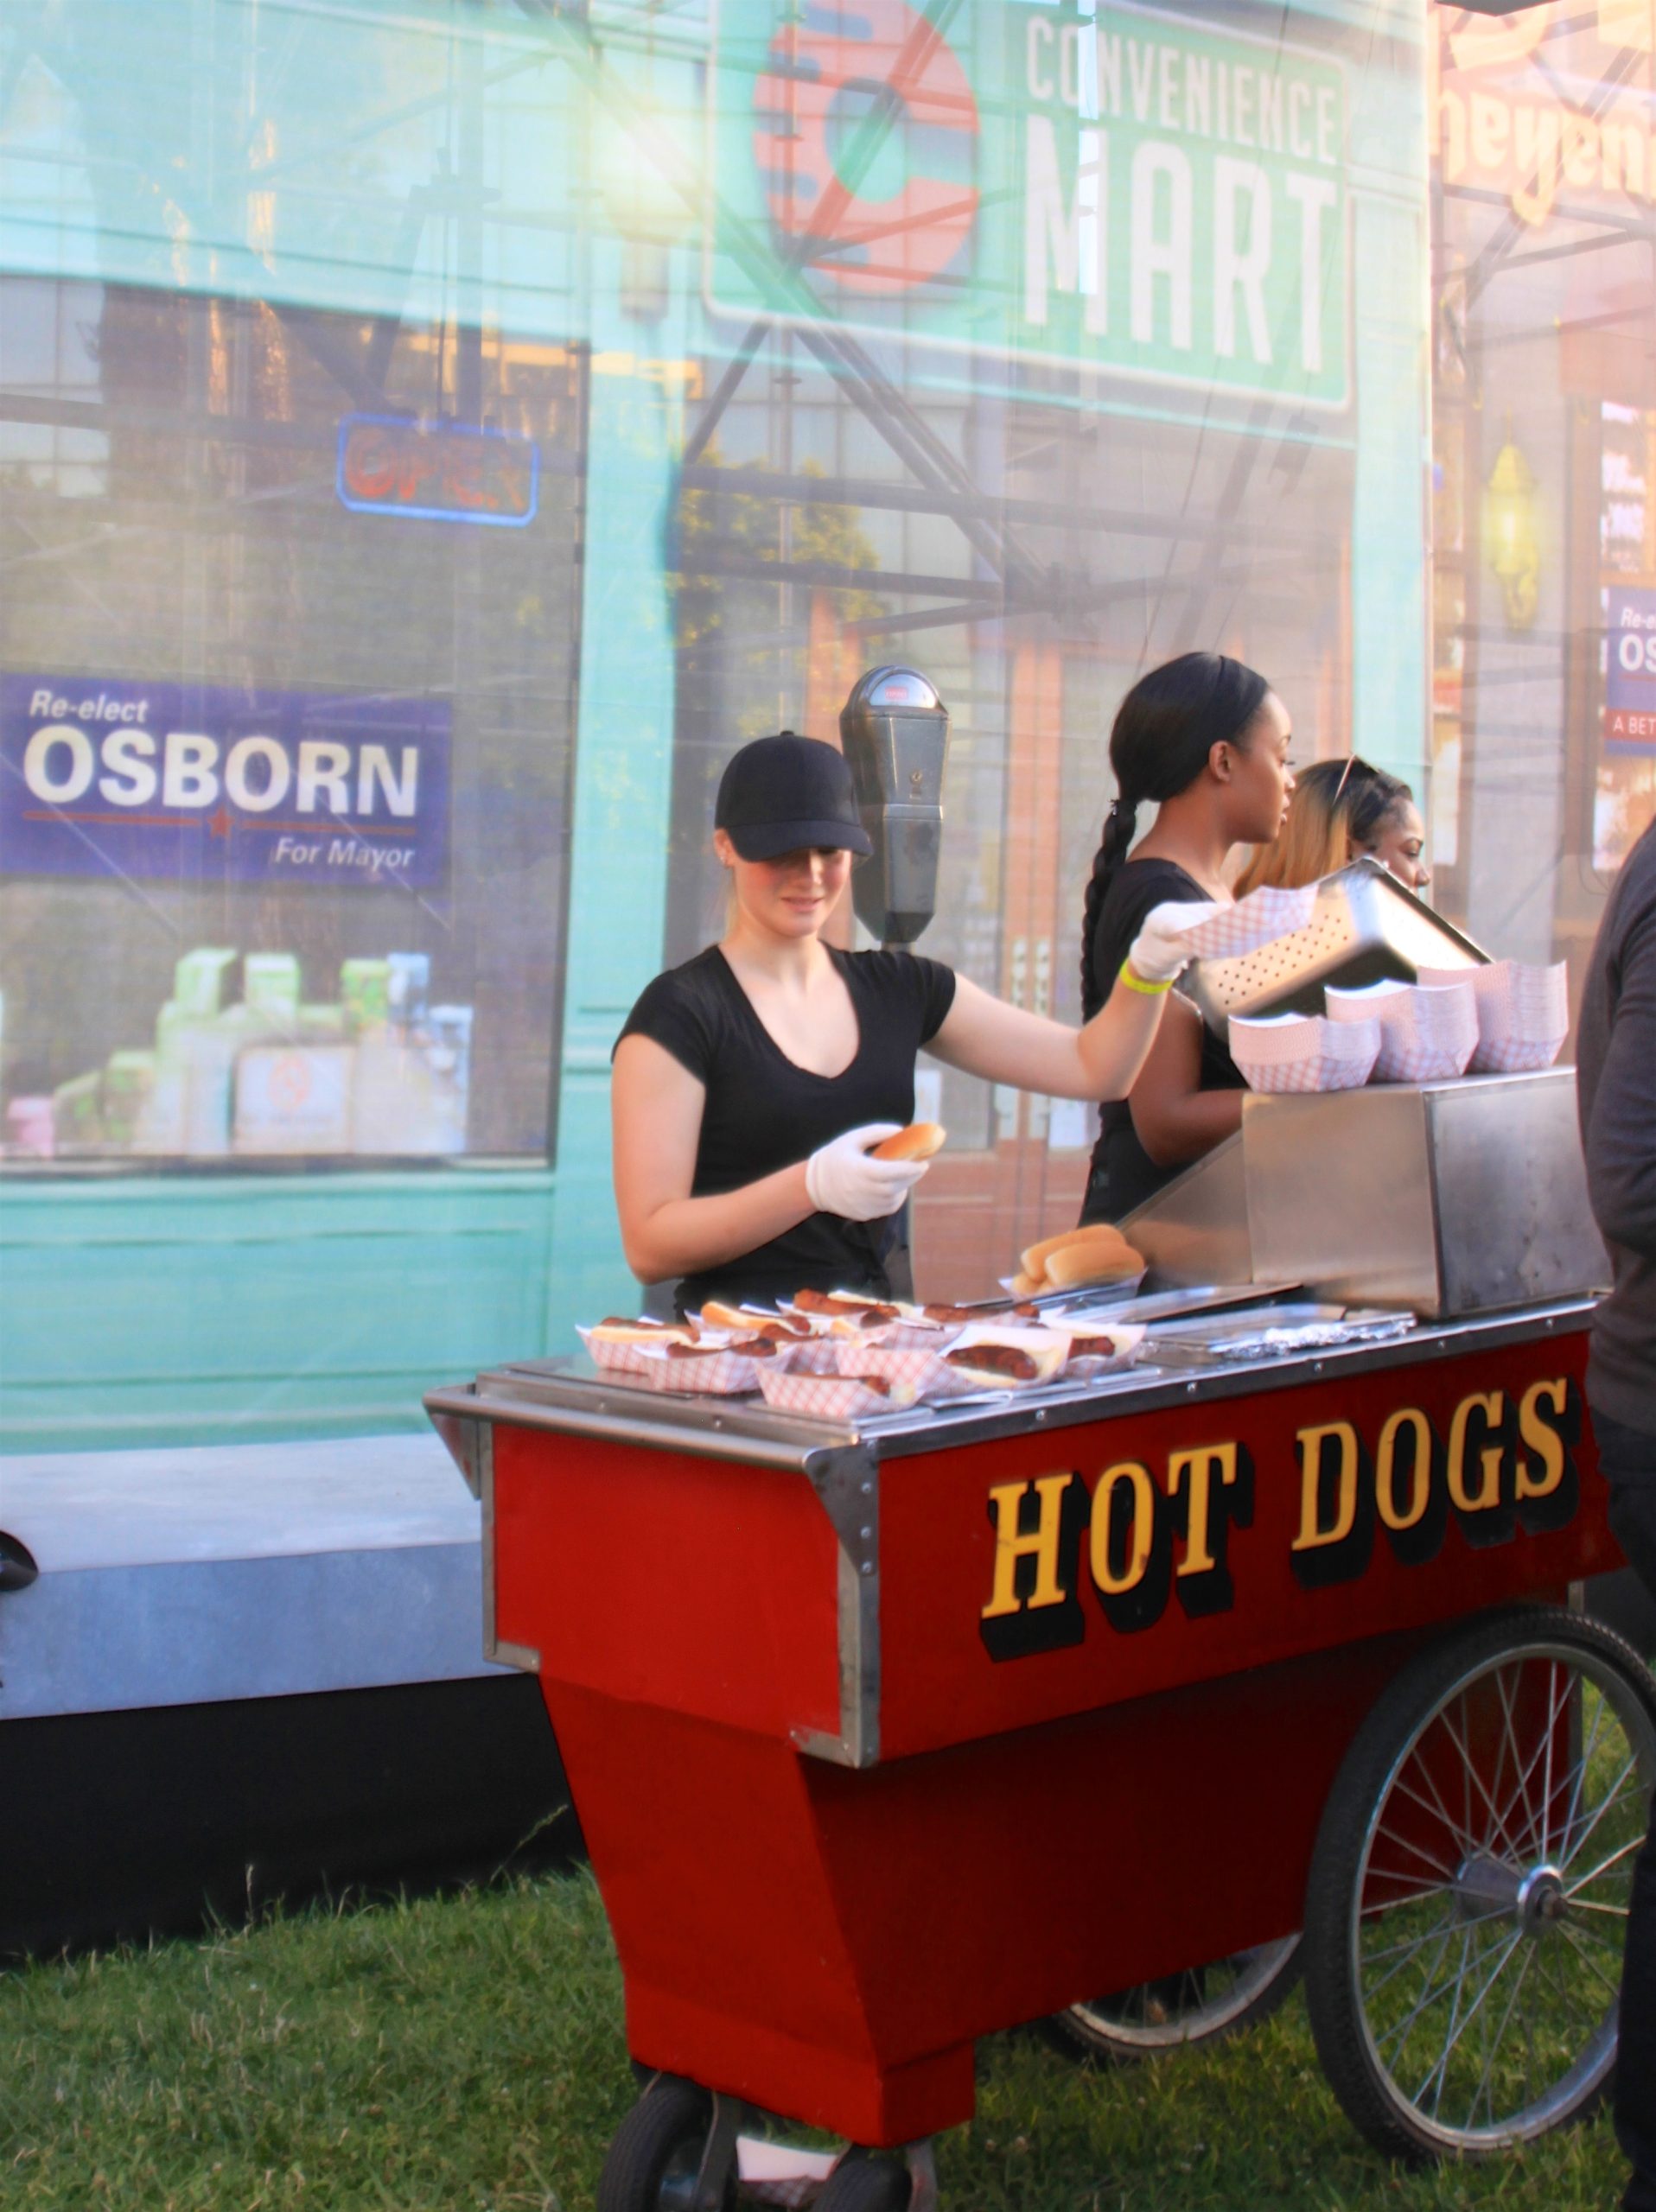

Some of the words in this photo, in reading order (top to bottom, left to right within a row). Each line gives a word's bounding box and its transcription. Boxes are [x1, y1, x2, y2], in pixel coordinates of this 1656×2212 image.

[1026, 15, 1340, 165] CONVENIENCE
[1024, 113, 1338, 374] MART
[29, 690, 149, 722] Re-elect
[1613, 715, 1624, 733] A
[24, 724, 418, 817] OSBORN
[274, 836, 322, 864] For
[328, 838, 416, 873] Mayor
[981, 1441, 1238, 1620] HOT
[1291, 1377, 1568, 1551] DOGS
